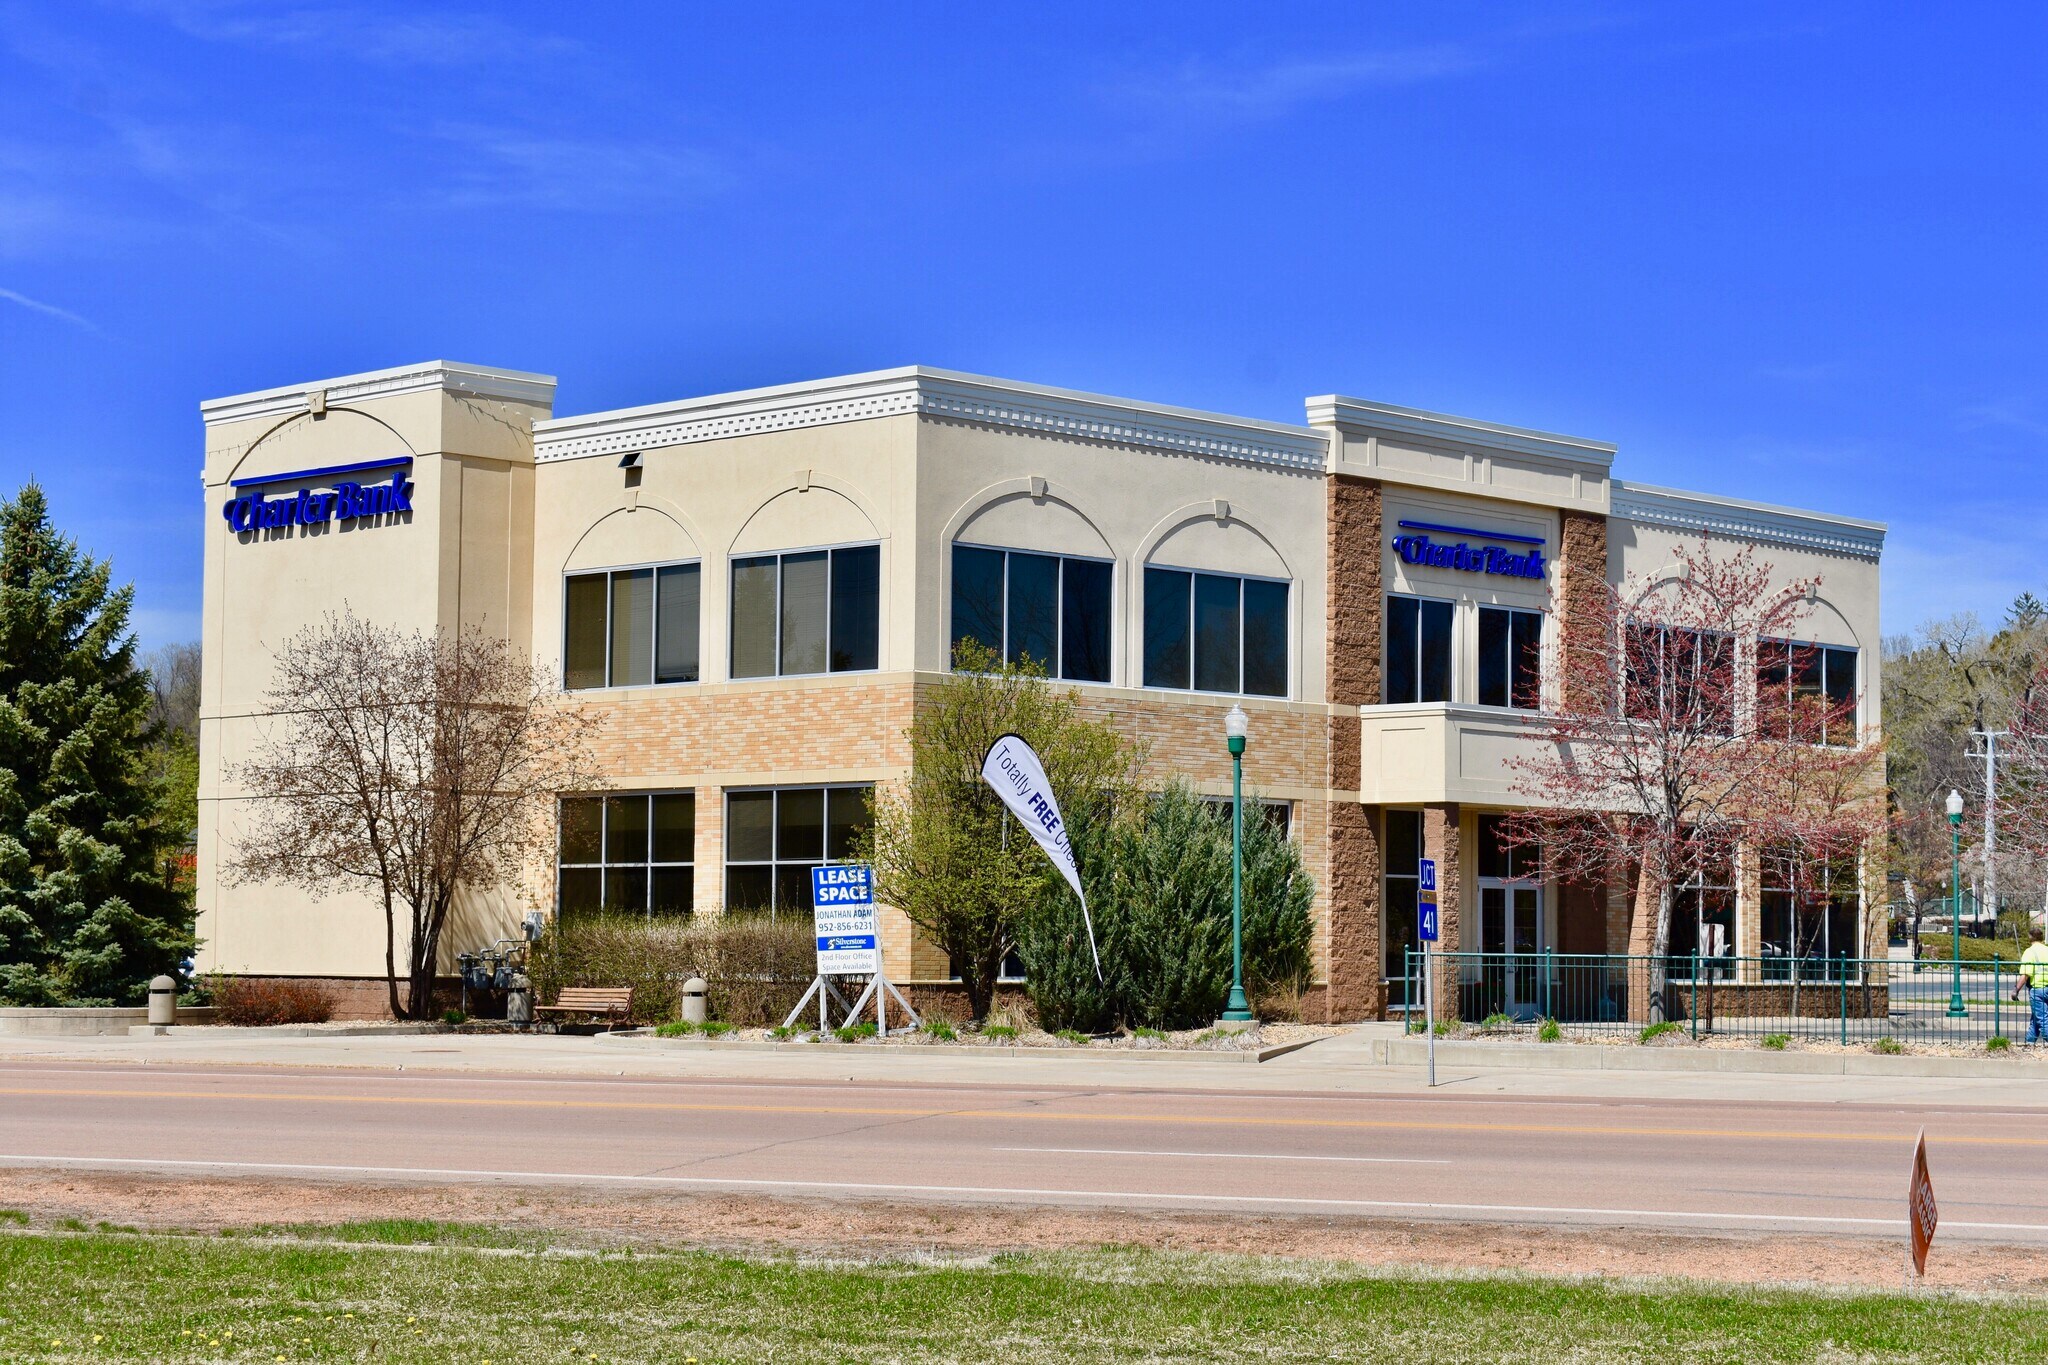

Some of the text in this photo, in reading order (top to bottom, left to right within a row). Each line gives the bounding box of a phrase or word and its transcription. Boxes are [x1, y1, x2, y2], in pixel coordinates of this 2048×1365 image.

[222, 472, 415, 533] Charter Bank
[1392, 535, 1546, 579] Charter Bank
[995, 744, 1033, 797] Totally
[1028, 791, 1061, 834] FREE
[818, 869, 867, 885] LEASE
[1421, 864, 1434, 886] JCT
[819, 886, 868, 902] SPACE
[816, 909, 872, 920] JONATHAN ADAM
[1423, 911, 1434, 934] 41
[818, 921, 872, 932] 952-856-6231
[835, 937, 867, 946] Silverstone
[821, 952, 873, 961] 2nd Floor Office
[822, 962, 873, 971] Space Available
